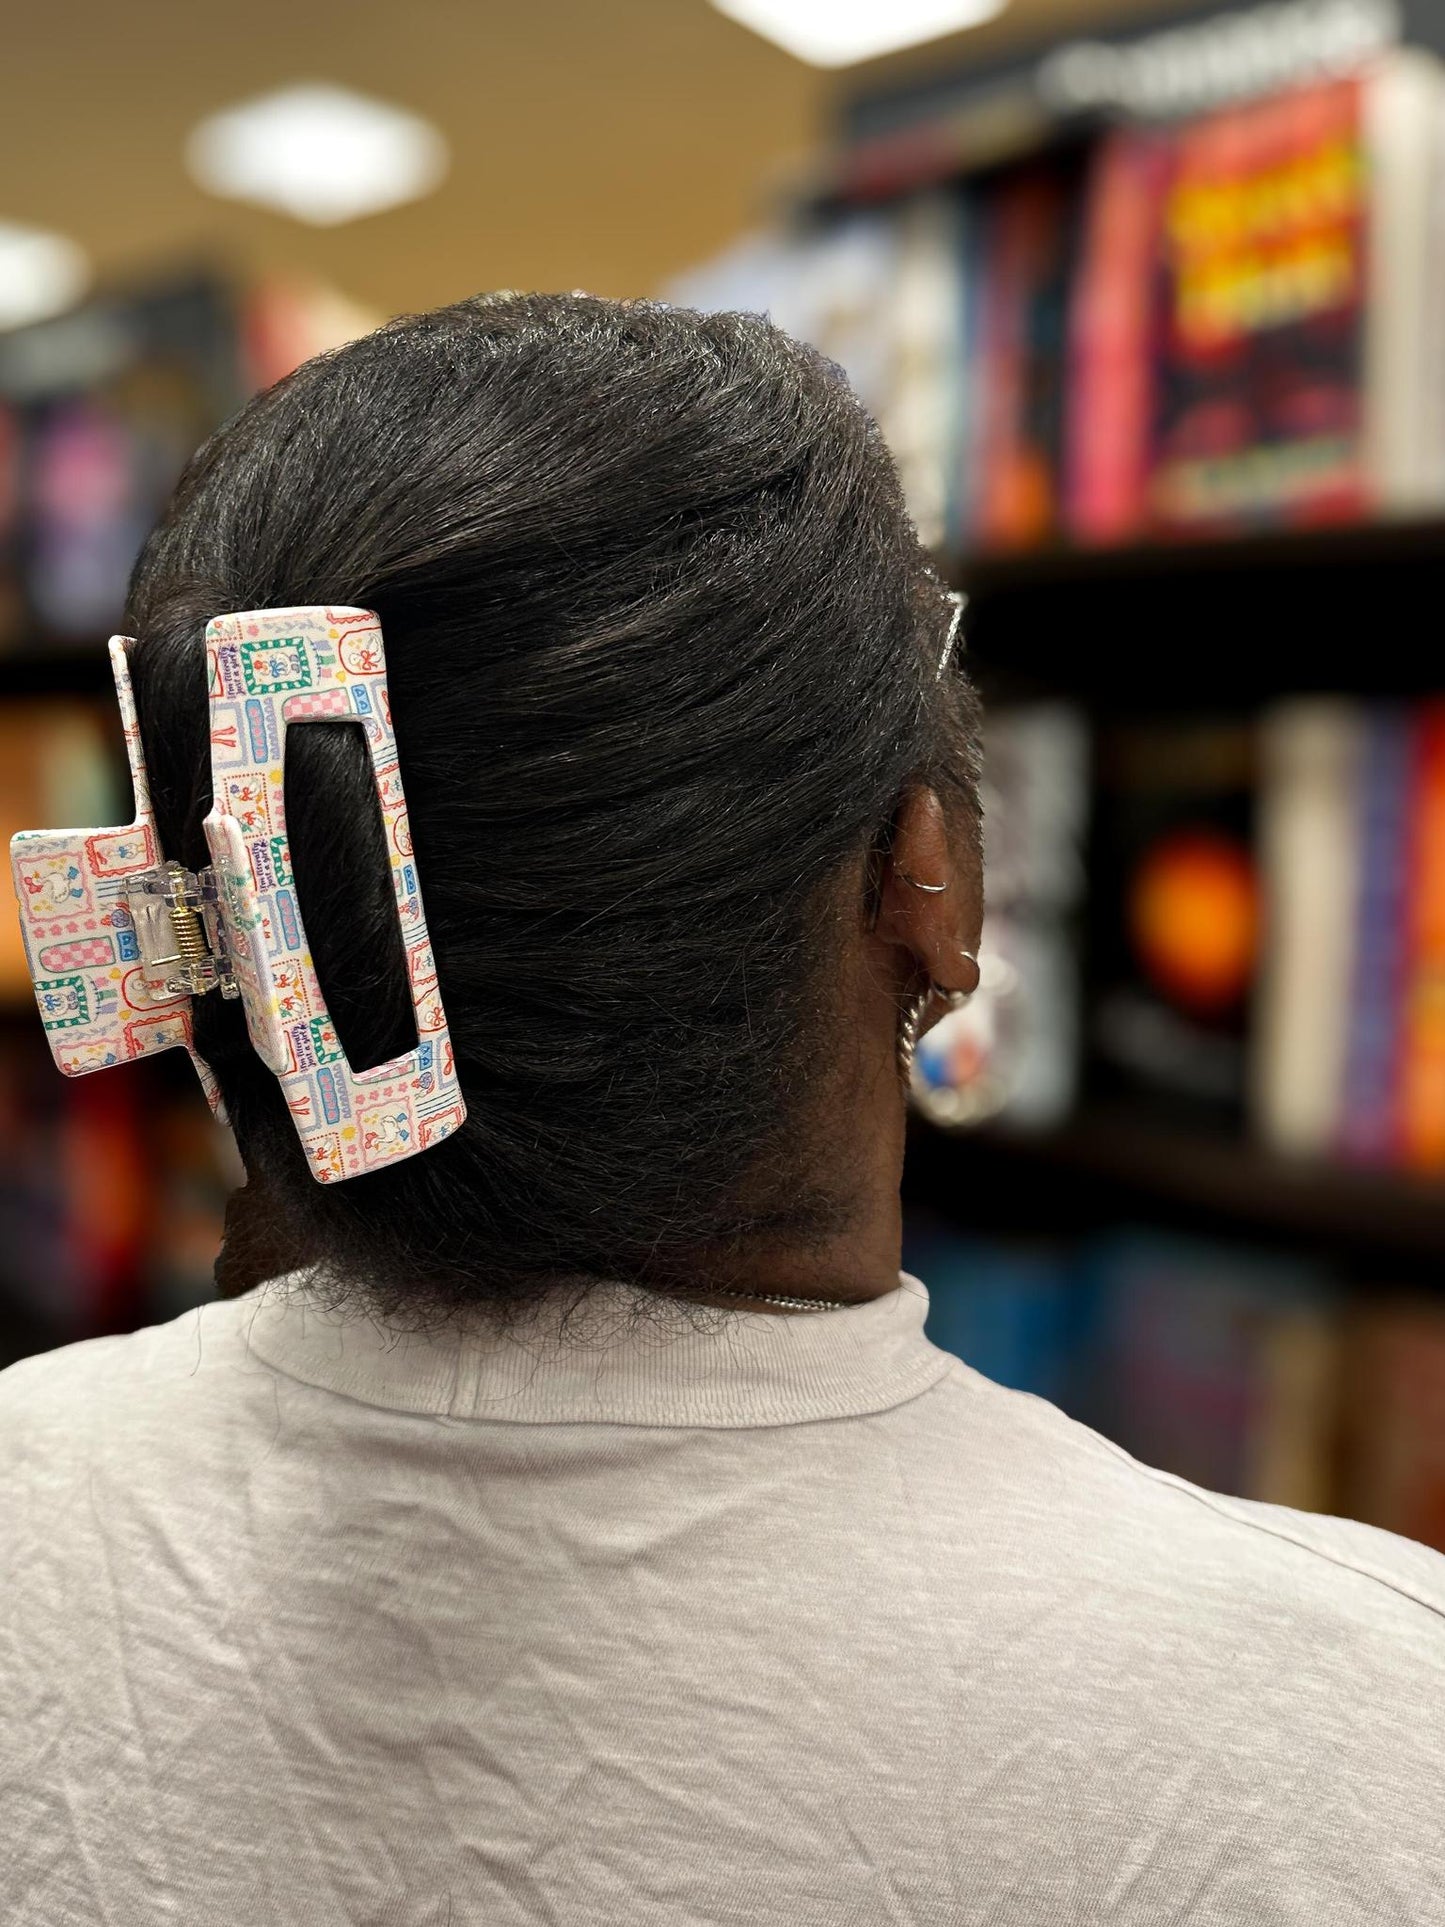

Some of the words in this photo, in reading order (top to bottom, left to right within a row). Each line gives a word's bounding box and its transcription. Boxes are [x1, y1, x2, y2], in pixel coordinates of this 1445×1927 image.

[220, 647, 232, 682] literally
[228, 653, 240, 669] girl
[234, 679, 246, 696] just
[252, 843, 264, 876] literally
[259, 849, 270, 863] girl
[265, 873, 276, 889] just
[291, 1026, 305, 1057] literally
[299, 1031, 310, 1044] girl
[306, 1053, 316, 1067] just
